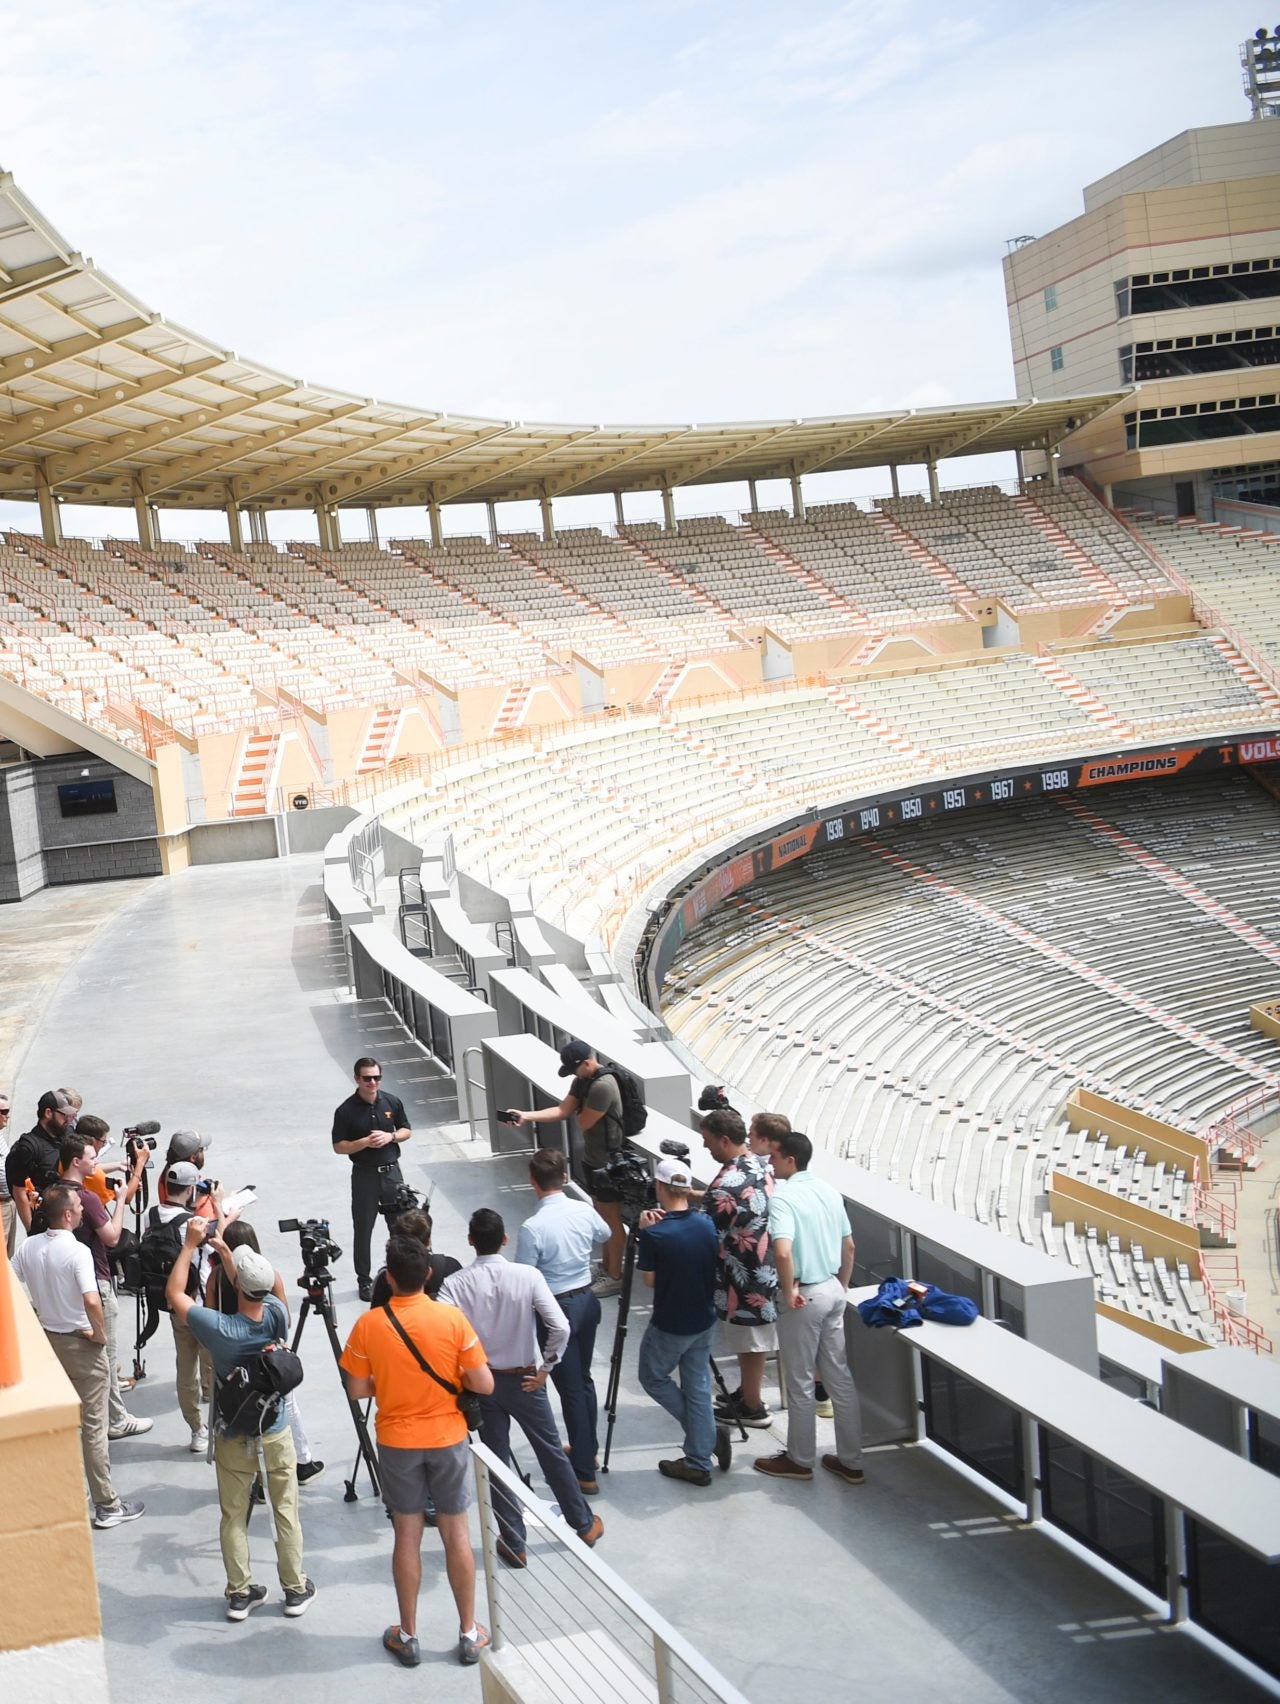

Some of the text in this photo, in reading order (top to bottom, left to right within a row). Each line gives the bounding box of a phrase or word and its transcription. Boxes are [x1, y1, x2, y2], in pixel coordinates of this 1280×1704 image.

[778, 756, 1177, 858] NATIONAL 1938 1940 1950 1951 1967 1998 CHAMPIONS
